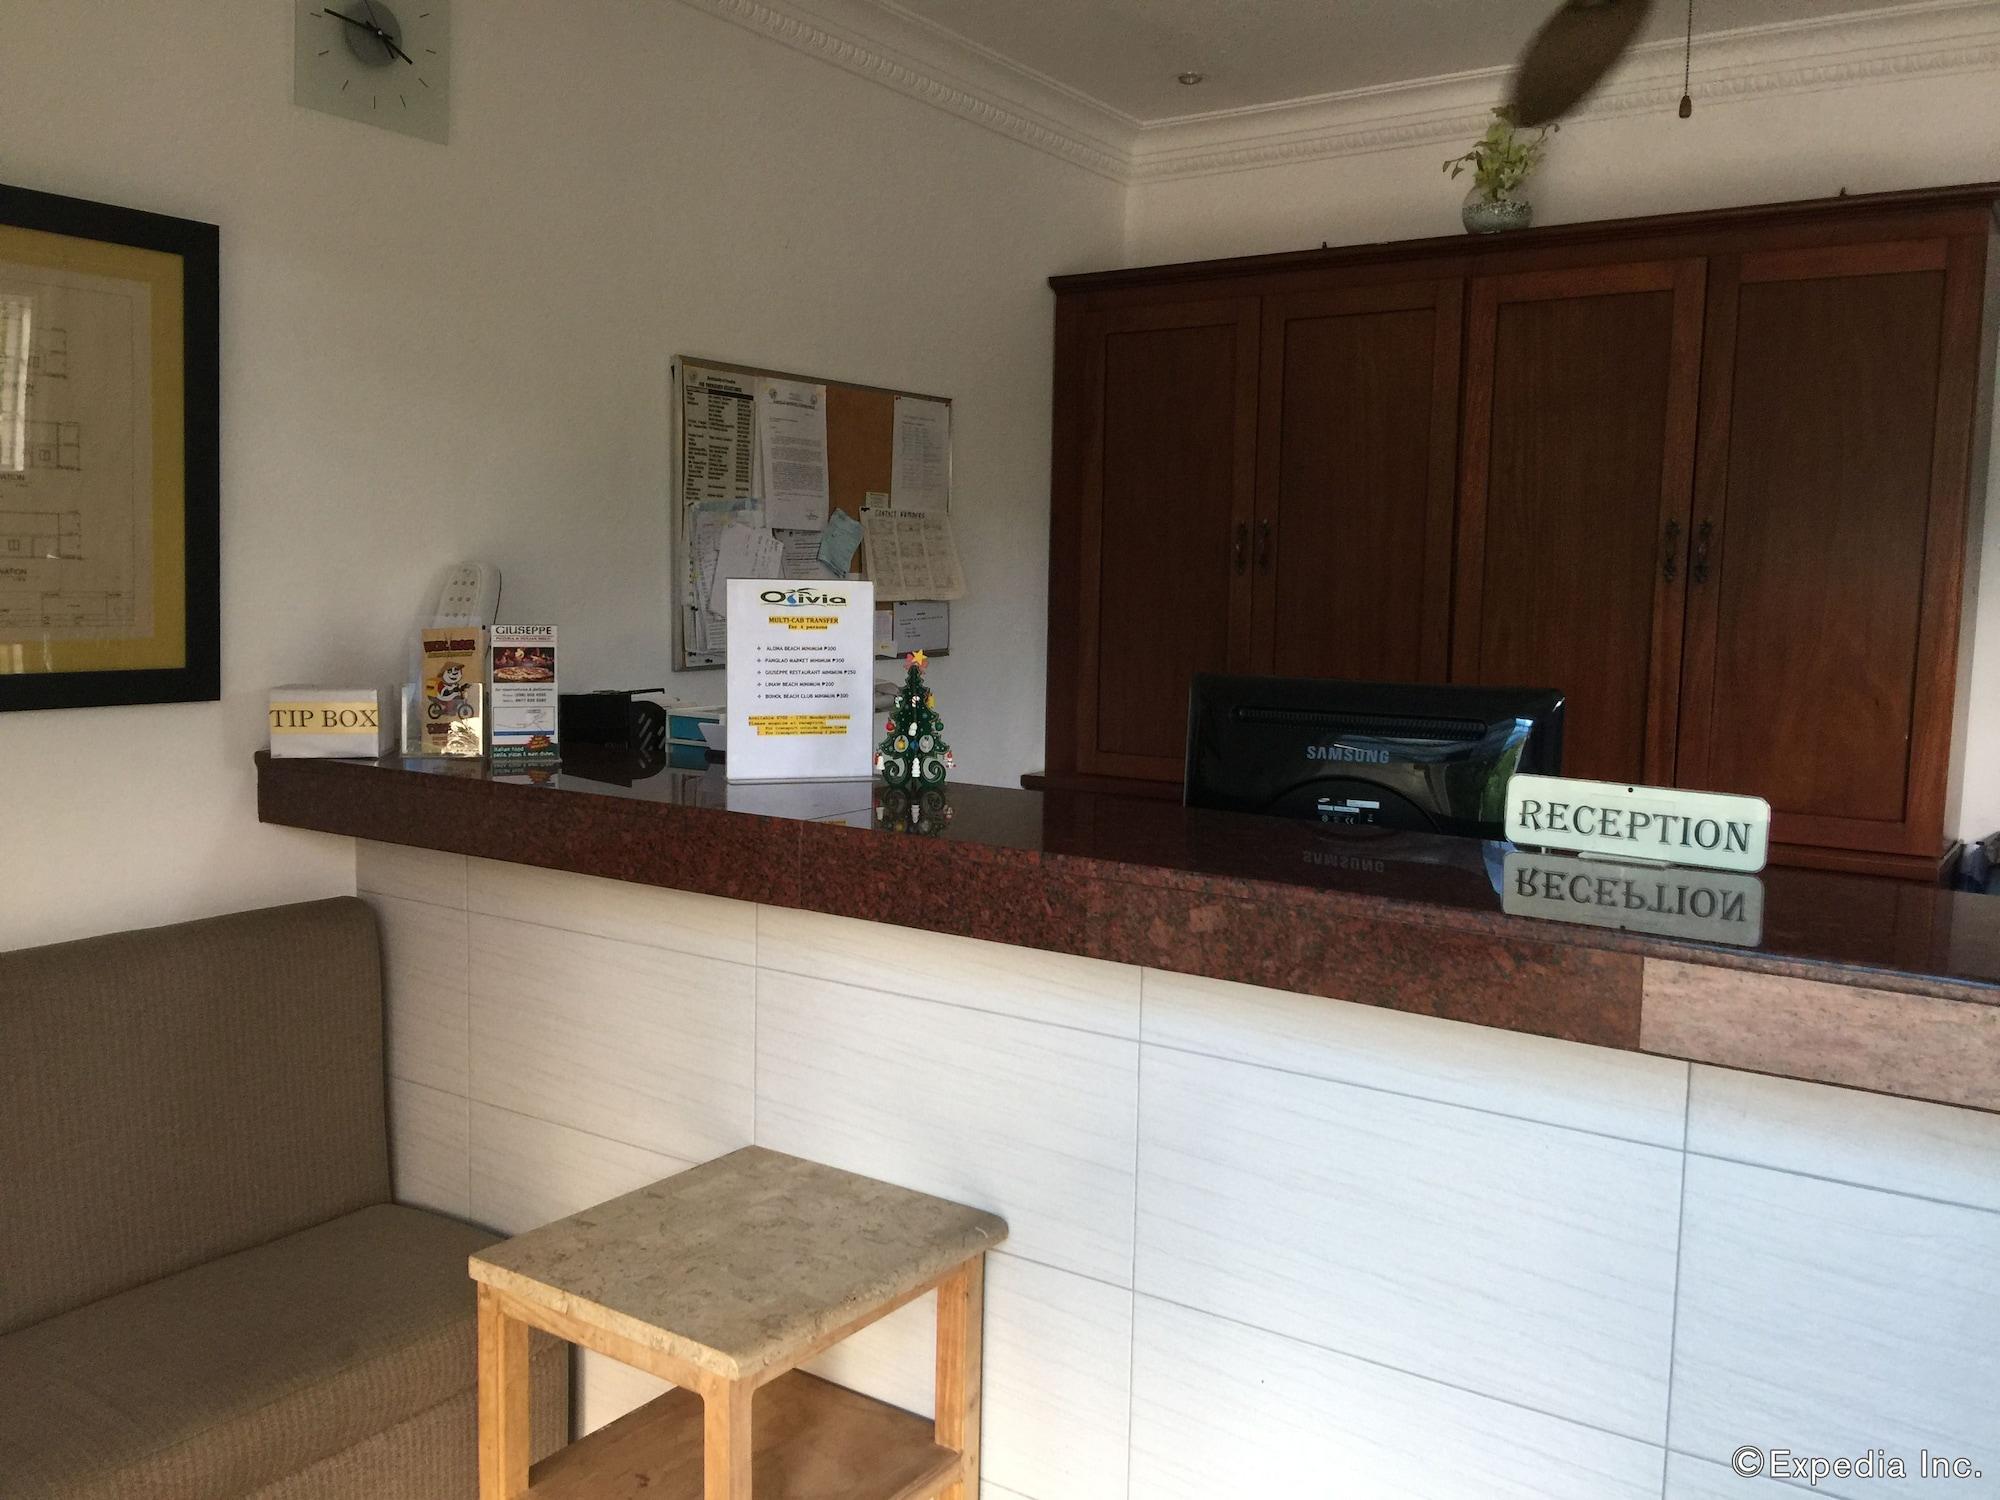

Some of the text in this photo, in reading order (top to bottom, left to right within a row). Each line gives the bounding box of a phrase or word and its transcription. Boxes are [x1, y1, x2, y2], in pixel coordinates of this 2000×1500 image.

[768, 616, 839, 624] MULTI-CAB TRANSFER
[495, 626, 552, 635] GIUSEPPE
[269, 708, 378, 729] TIP BOX
[1306, 744, 1390, 764] SAMSUNG
[1518, 799, 1754, 855] RECEPTION
